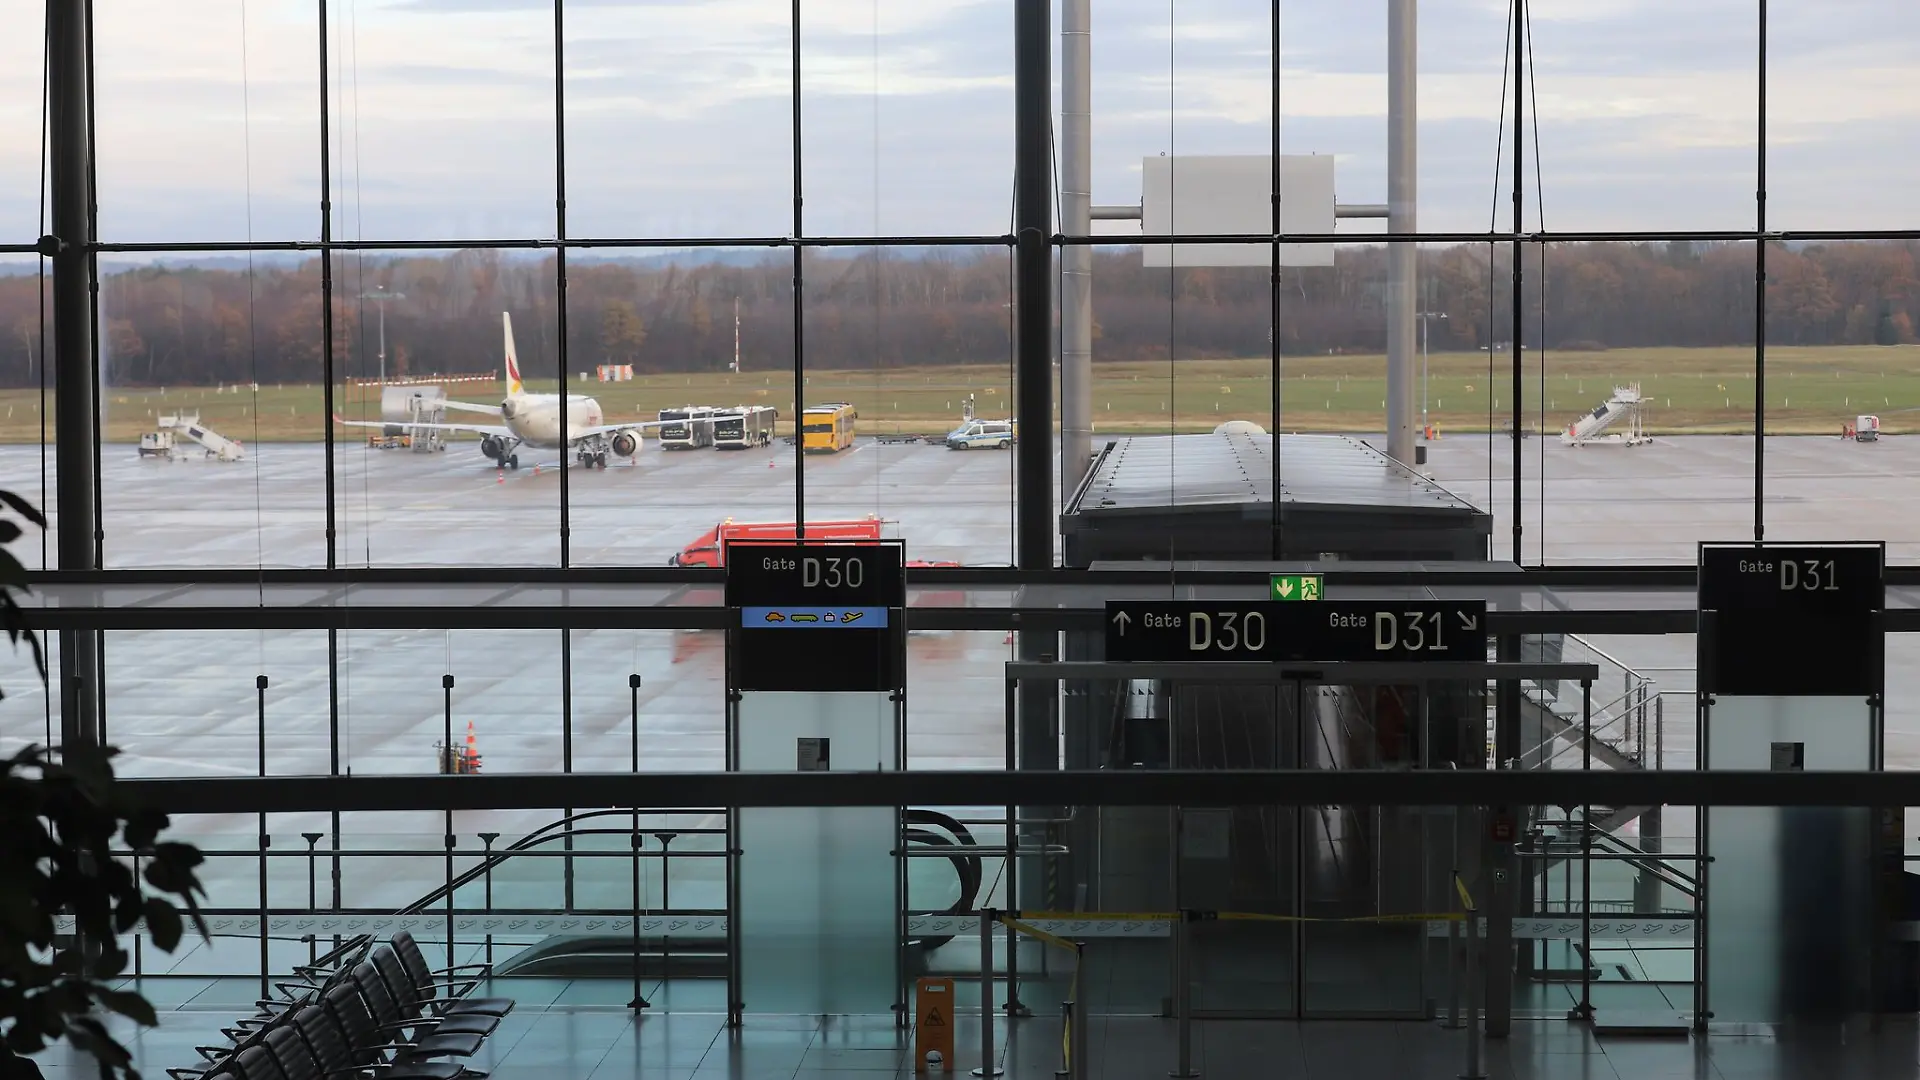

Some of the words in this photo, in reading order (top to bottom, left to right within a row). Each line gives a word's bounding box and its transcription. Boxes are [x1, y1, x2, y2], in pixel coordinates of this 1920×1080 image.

[764, 557, 795, 569] Gate
[803, 558, 862, 587] D30
[1740, 560, 1772, 572] Gate
[1781, 560, 1839, 590] D31
[1145, 613, 1181, 627] Gate
[1190, 612, 1264, 650] D30
[1330, 612, 1366, 627] Gate
[1375, 612, 1448, 650] D31
